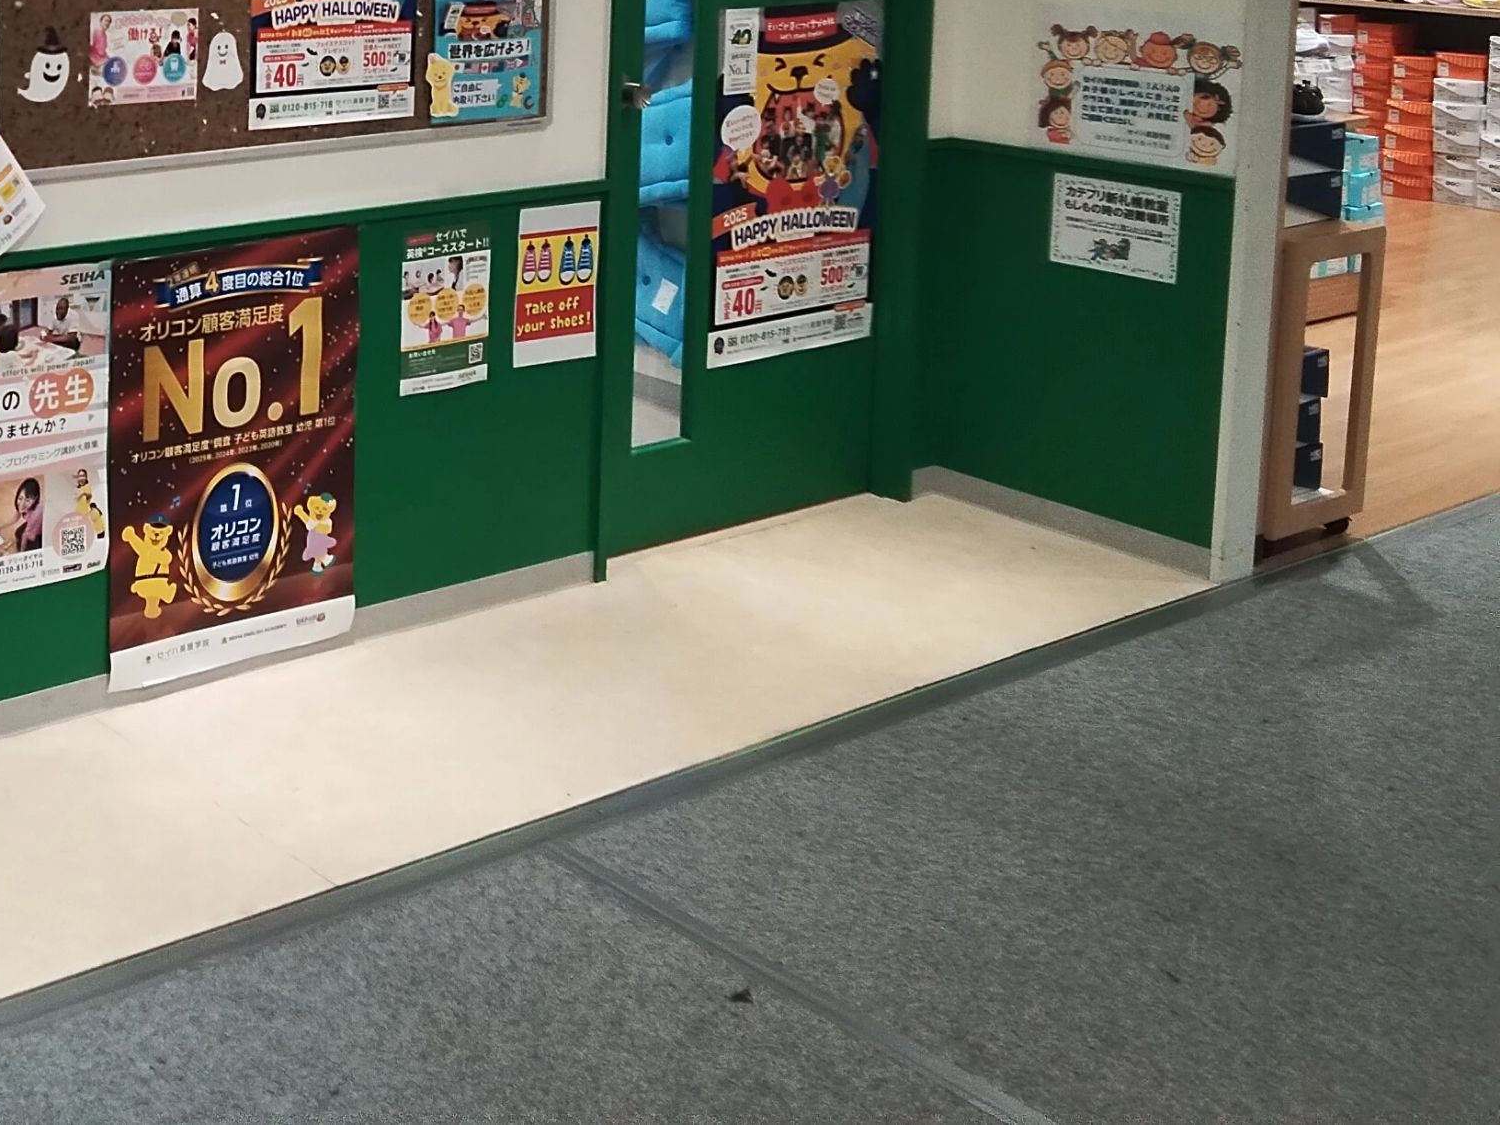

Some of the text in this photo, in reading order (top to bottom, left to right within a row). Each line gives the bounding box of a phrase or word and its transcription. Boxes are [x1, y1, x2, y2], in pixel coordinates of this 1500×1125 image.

[274, 0, 398, 26] HAPPY HALLOWEEN
[363, 52, 387, 68] 500
[449, 40, 531, 59] 世界を広げよう！
[273, 63, 297, 89] 40
[435, 228, 468, 243] セイハで
[733, 211, 857, 247] HAPPY HALLOWEEN
[60, 270, 106, 286] SEIHA
[175, 269, 305, 305] 通算4度目の総合1位
[524, 296, 580, 316] Take off
[732, 288, 756, 317] 40
[138, 302, 286, 342] オリコン顧客満足度
[516, 320, 546, 337] your
[141, 296, 324, 443] No.1
[210, 517, 263, 542] オリコン
